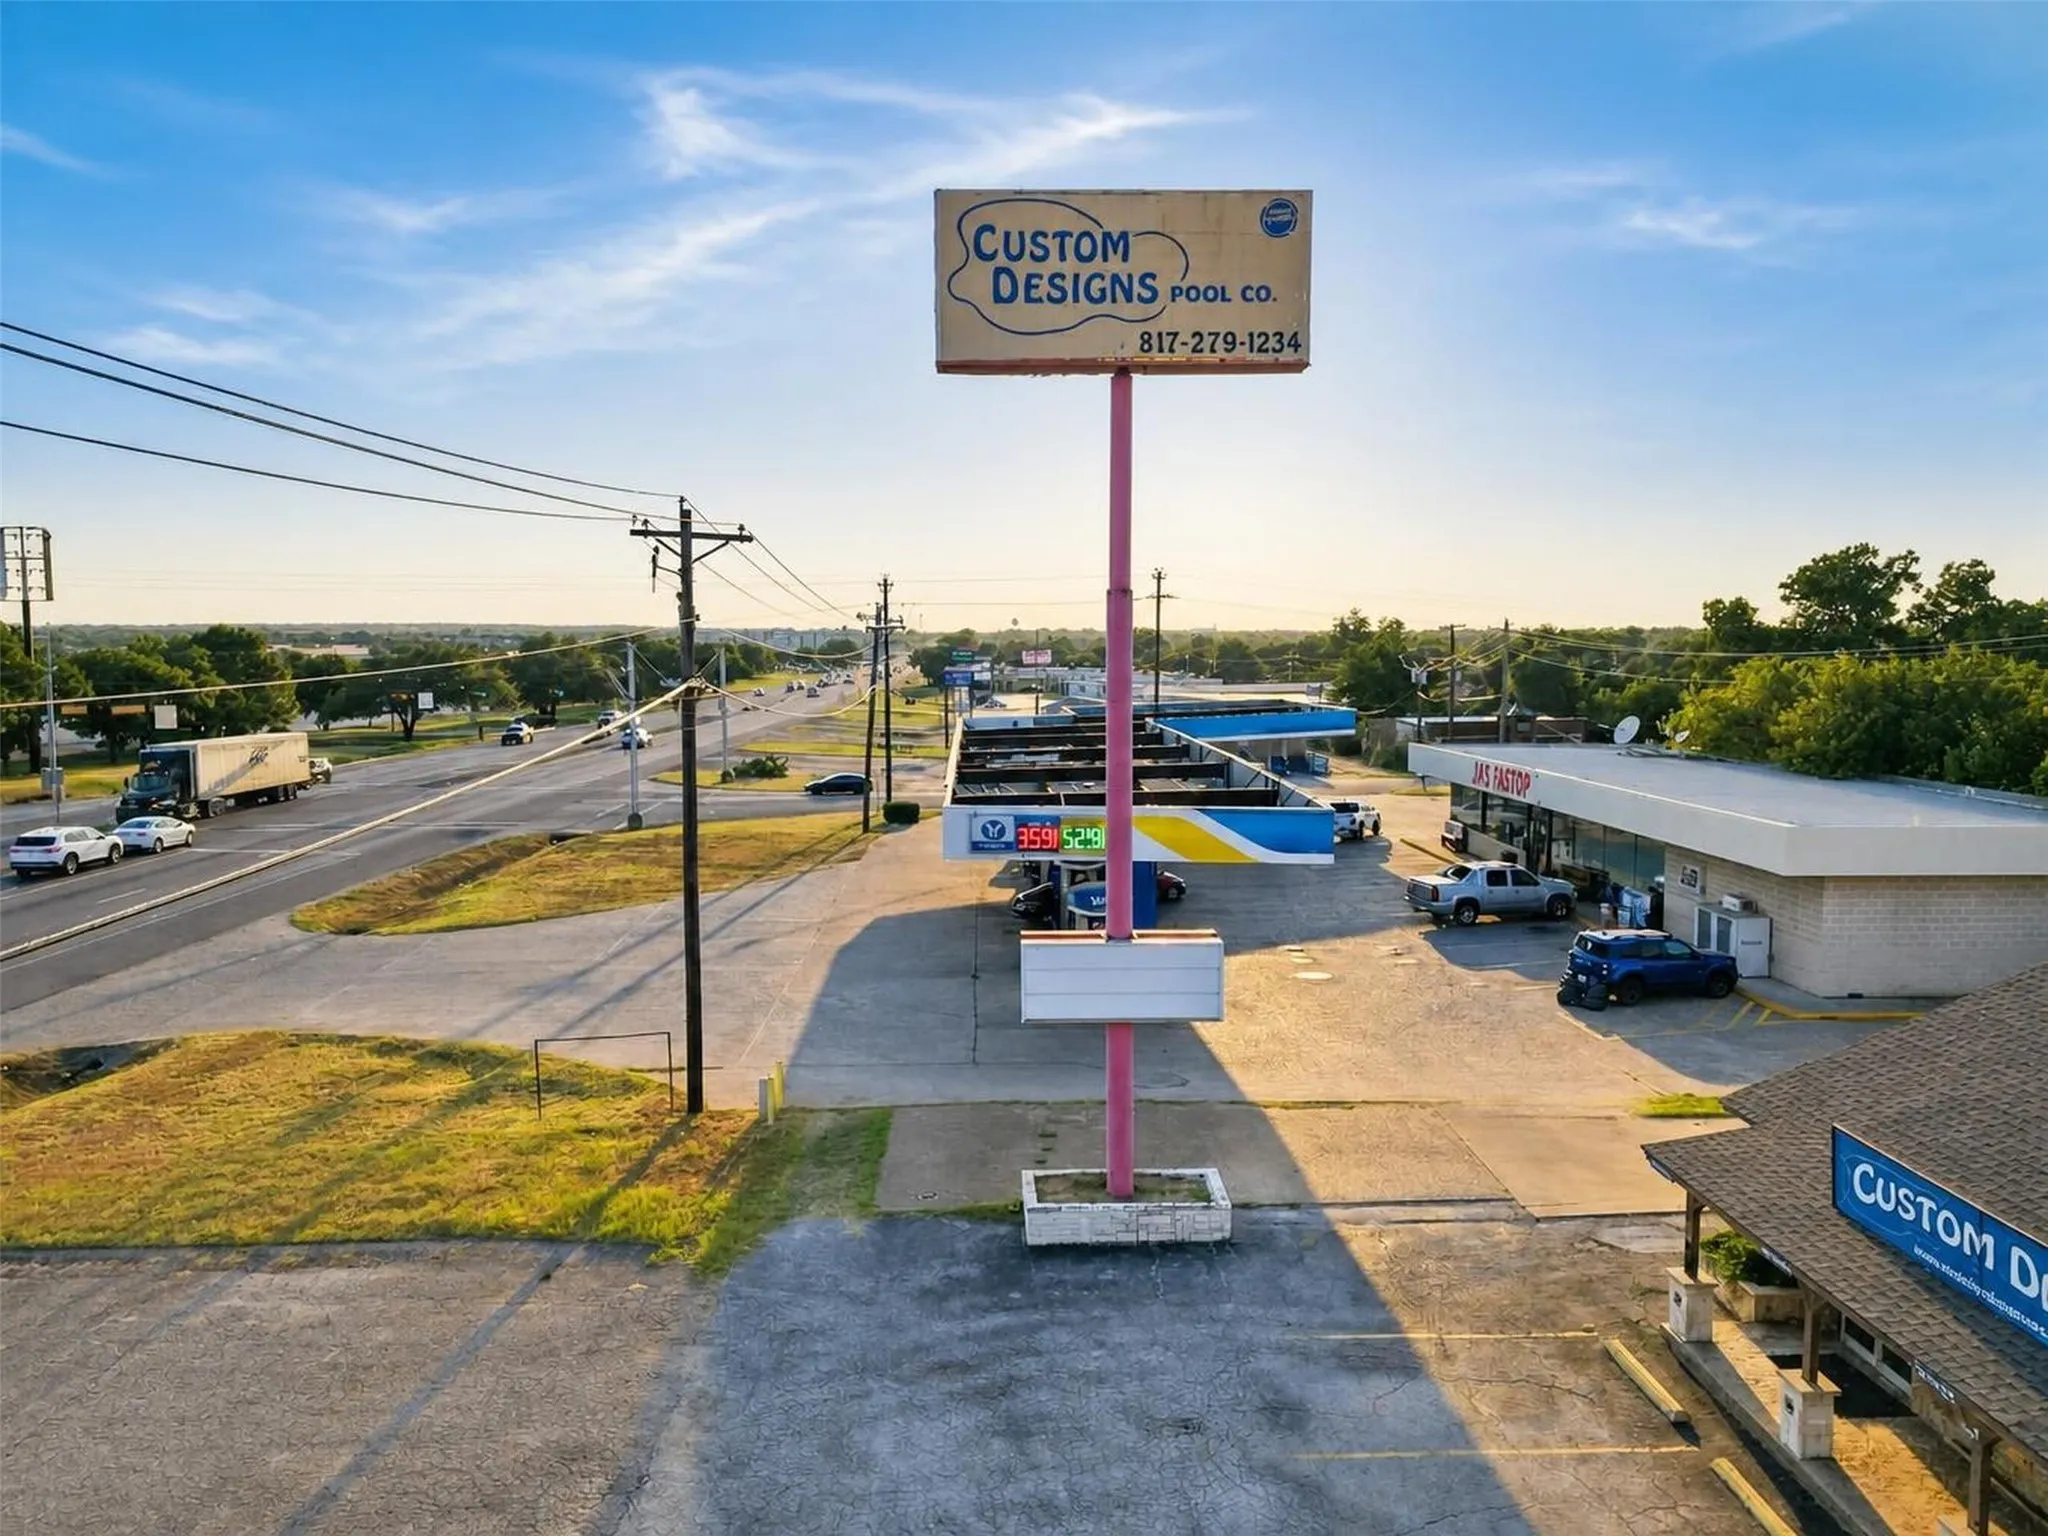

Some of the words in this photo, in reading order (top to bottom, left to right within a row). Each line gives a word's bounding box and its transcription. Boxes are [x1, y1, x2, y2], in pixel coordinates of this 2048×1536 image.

[973, 223, 1130, 264] CUSTOM
[991, 266, 1159, 304] DESIGNS
[1171, 285, 1232, 303] POOL
[1240, 285, 1278, 303] CO.
[1139, 331, 1302, 354] 817-279-1234
[1853, 1163, 1995, 1271] CUSTOM
